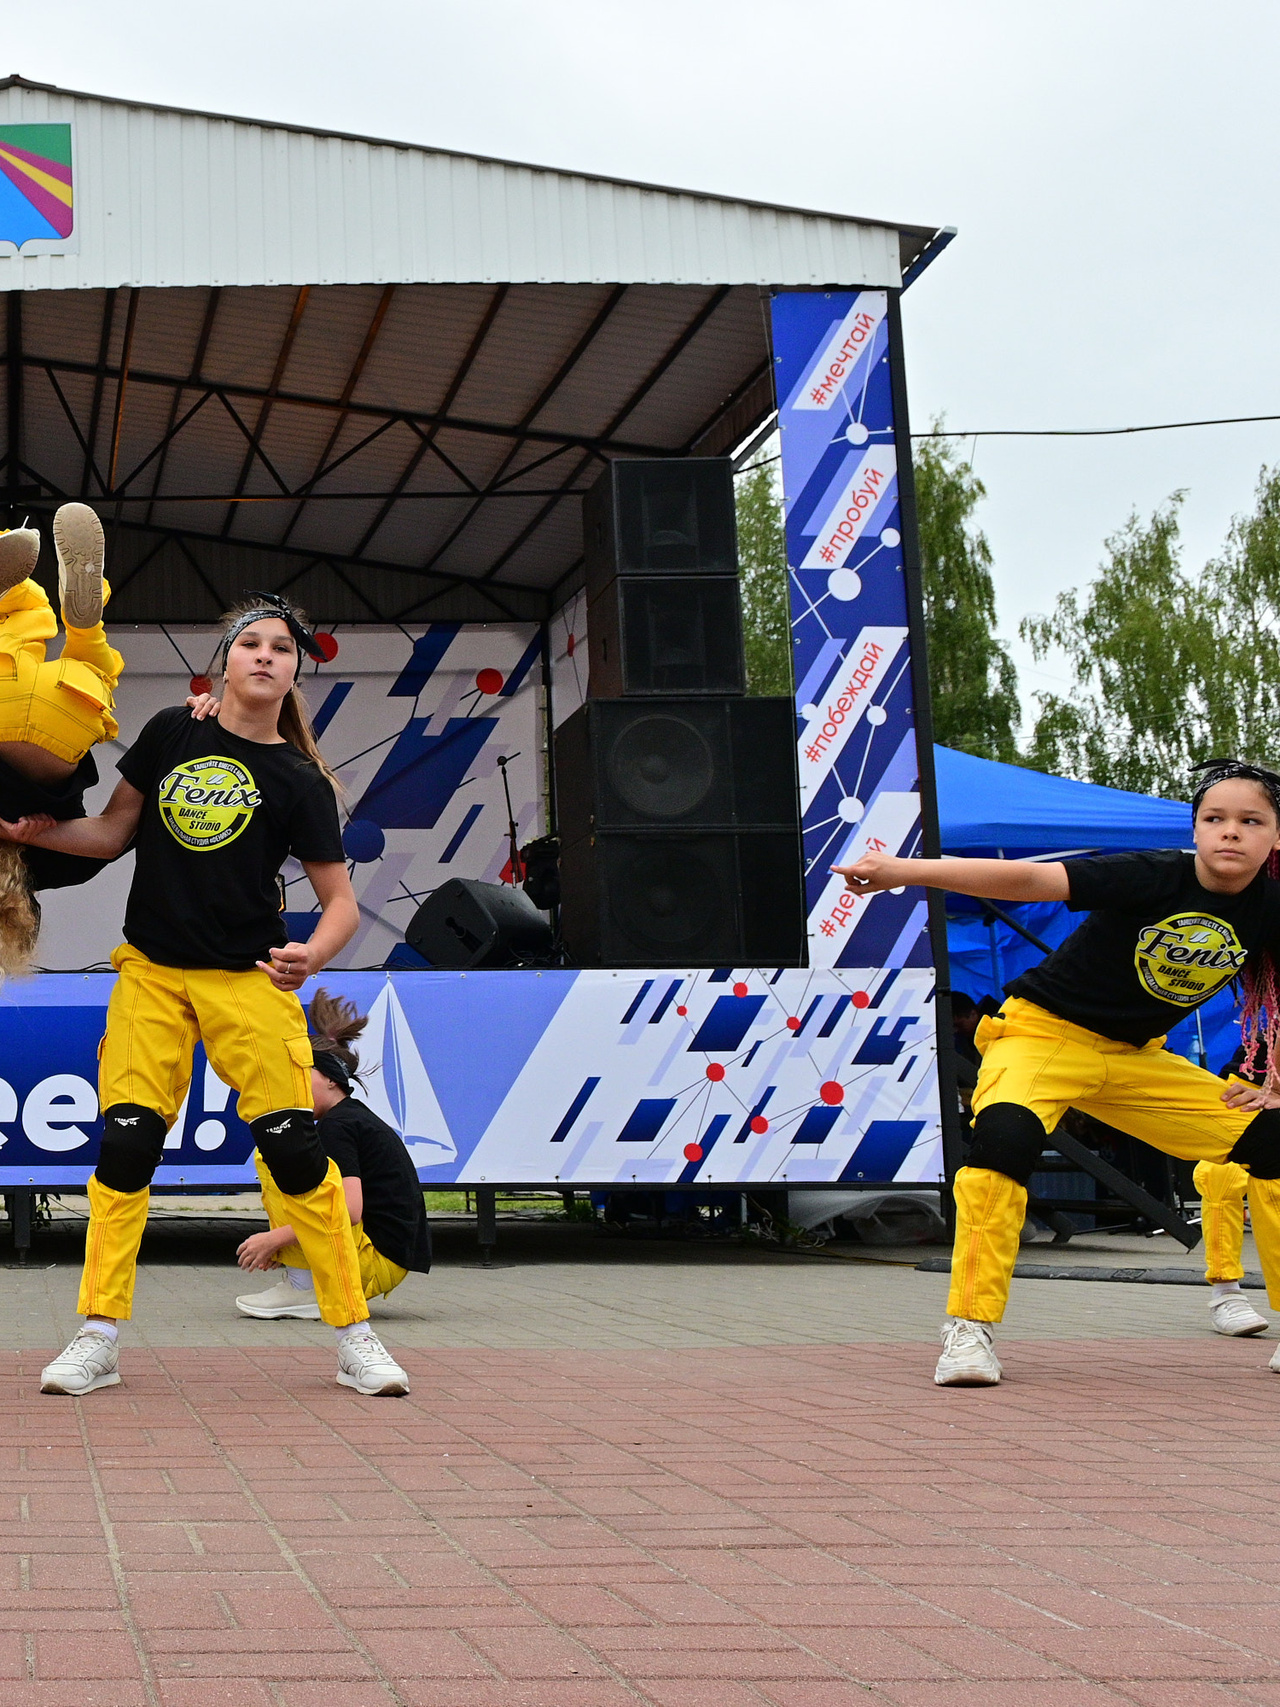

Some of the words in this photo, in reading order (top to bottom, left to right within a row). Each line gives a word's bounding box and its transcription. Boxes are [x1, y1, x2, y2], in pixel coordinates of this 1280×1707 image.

[812, 313, 873, 404] #мечтай
[820, 468, 884, 562] #пробуй
[805, 642, 884, 762] #побеждай
[159, 771, 262, 808] Fenix
[178, 807, 208, 820] DANCE
[189, 820, 221, 832] STUDIO
[819, 837, 888, 938] #дей
[1138, 925, 1248, 970] Fenix
[1157, 965, 1192, 978] DANCE
[1168, 978, 1206, 991] STUDIO
